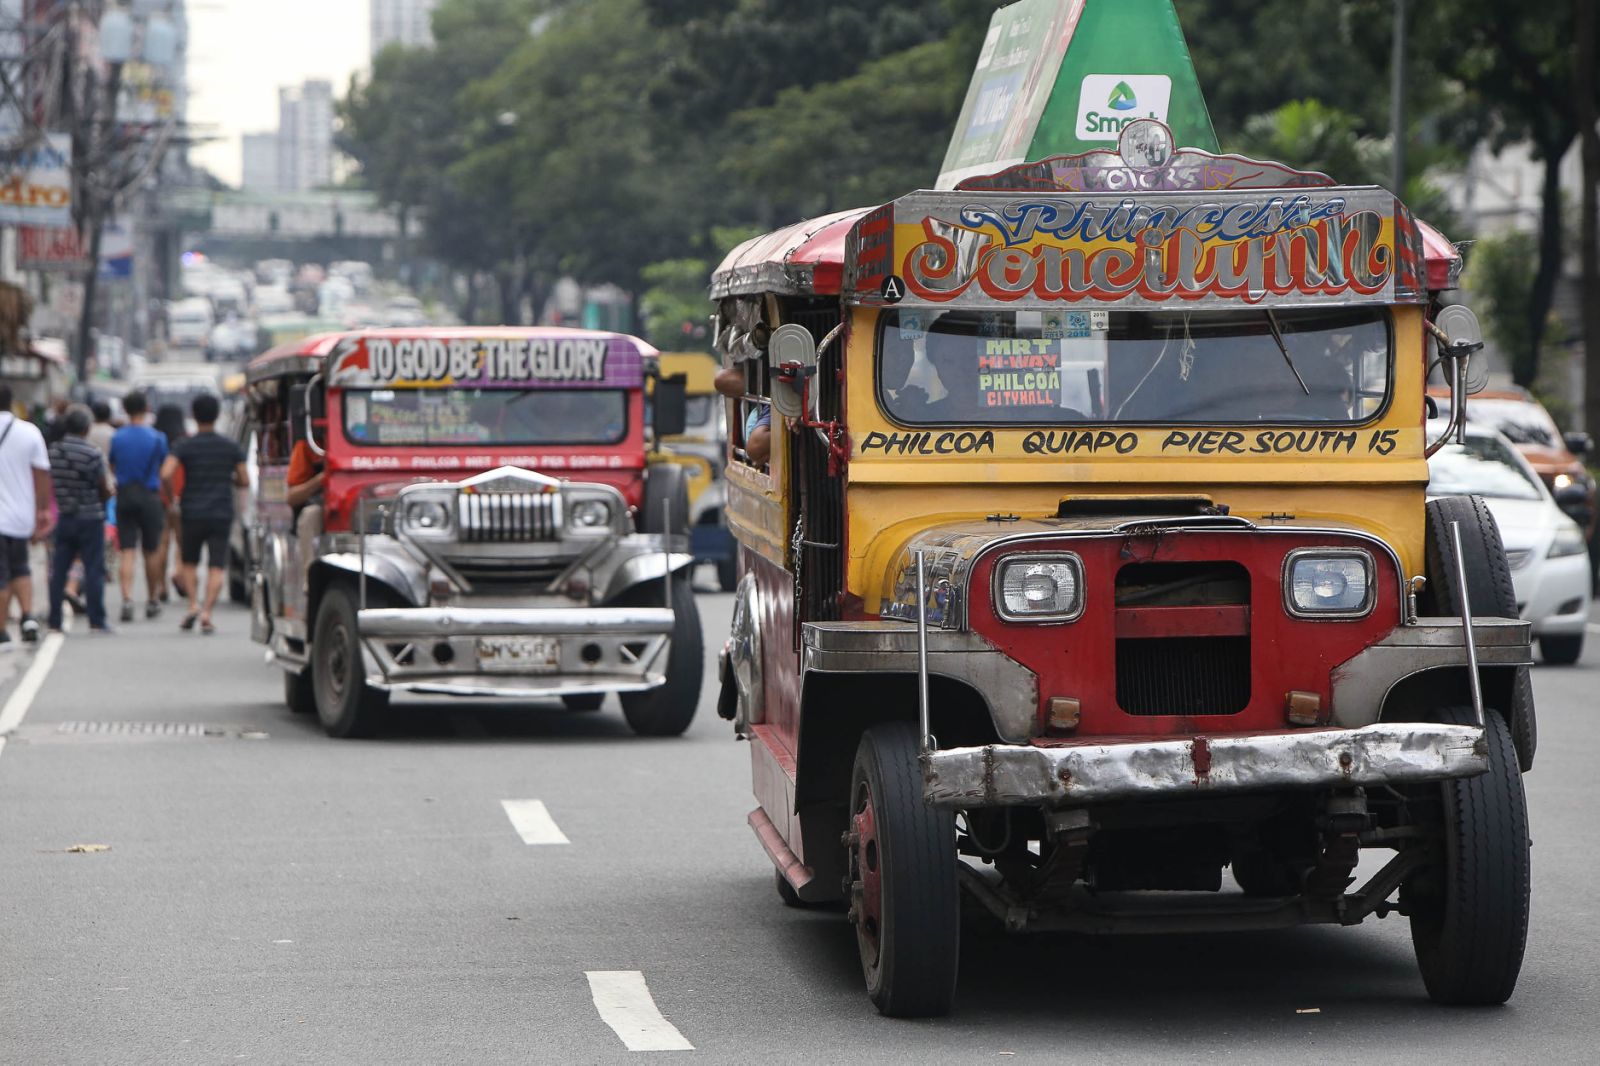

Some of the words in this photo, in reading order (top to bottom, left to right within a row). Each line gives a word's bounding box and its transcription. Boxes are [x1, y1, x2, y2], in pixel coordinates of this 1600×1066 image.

[960, 195, 1346, 247] Princess
[884, 277, 901, 298] A
[1067, 330, 1090, 338] 2016
[986, 339, 1053, 355] MRT
[366, 338, 396, 380] TO
[395, 338, 450, 380] GOD
[449, 338, 484, 380] BE
[482, 338, 531, 380] THE
[529, 338, 608, 381] GLORY
[979, 354, 1057, 368] HI-WAY
[980, 372, 1060, 390] PHILCOA
[861, 431, 994, 455] PHILCOA
[1022, 431, 1138, 455] QUIAPO
[1162, 430, 1246, 454] PIER
[1249, 430, 1357, 454] SOUTH
[1368, 429, 1399, 456] 15
